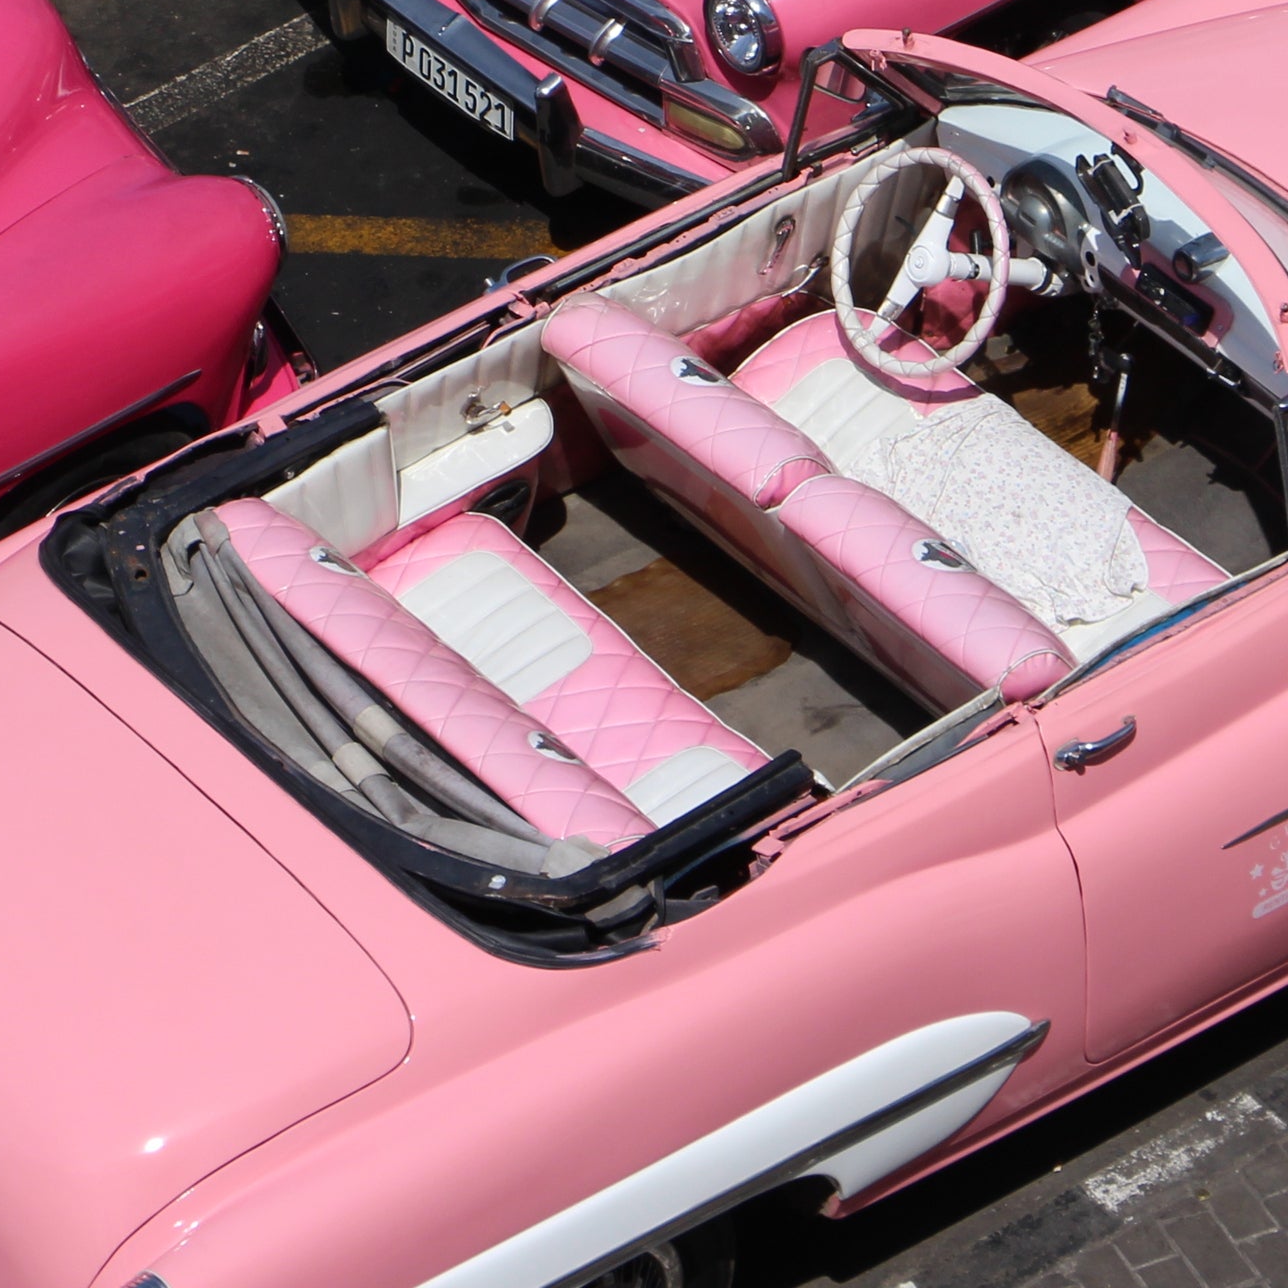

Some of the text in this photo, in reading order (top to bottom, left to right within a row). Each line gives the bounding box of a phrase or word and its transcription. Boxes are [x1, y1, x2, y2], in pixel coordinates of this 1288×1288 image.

[402, 31, 507, 134] P 031 521
